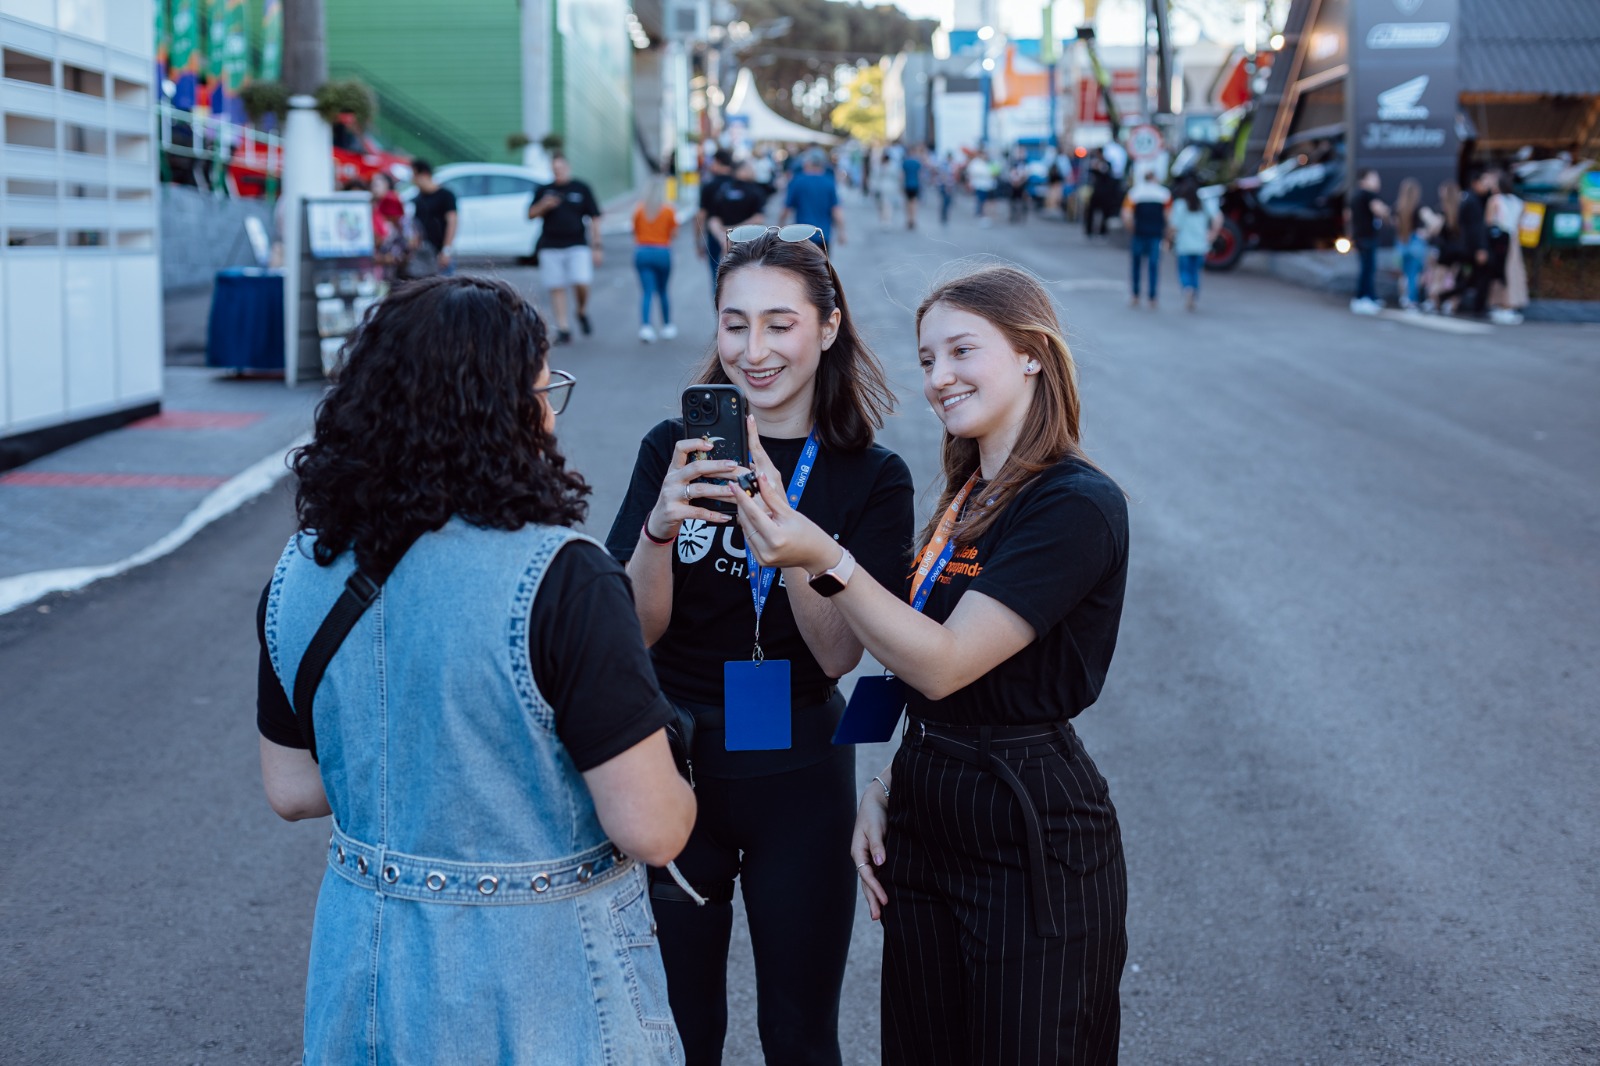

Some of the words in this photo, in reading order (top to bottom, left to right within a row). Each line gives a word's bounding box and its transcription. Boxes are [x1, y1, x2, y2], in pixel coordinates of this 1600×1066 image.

[797, 471, 808, 488] UNO
[922, 550, 934, 569] UNO
[930, 565, 943, 583] UNO
